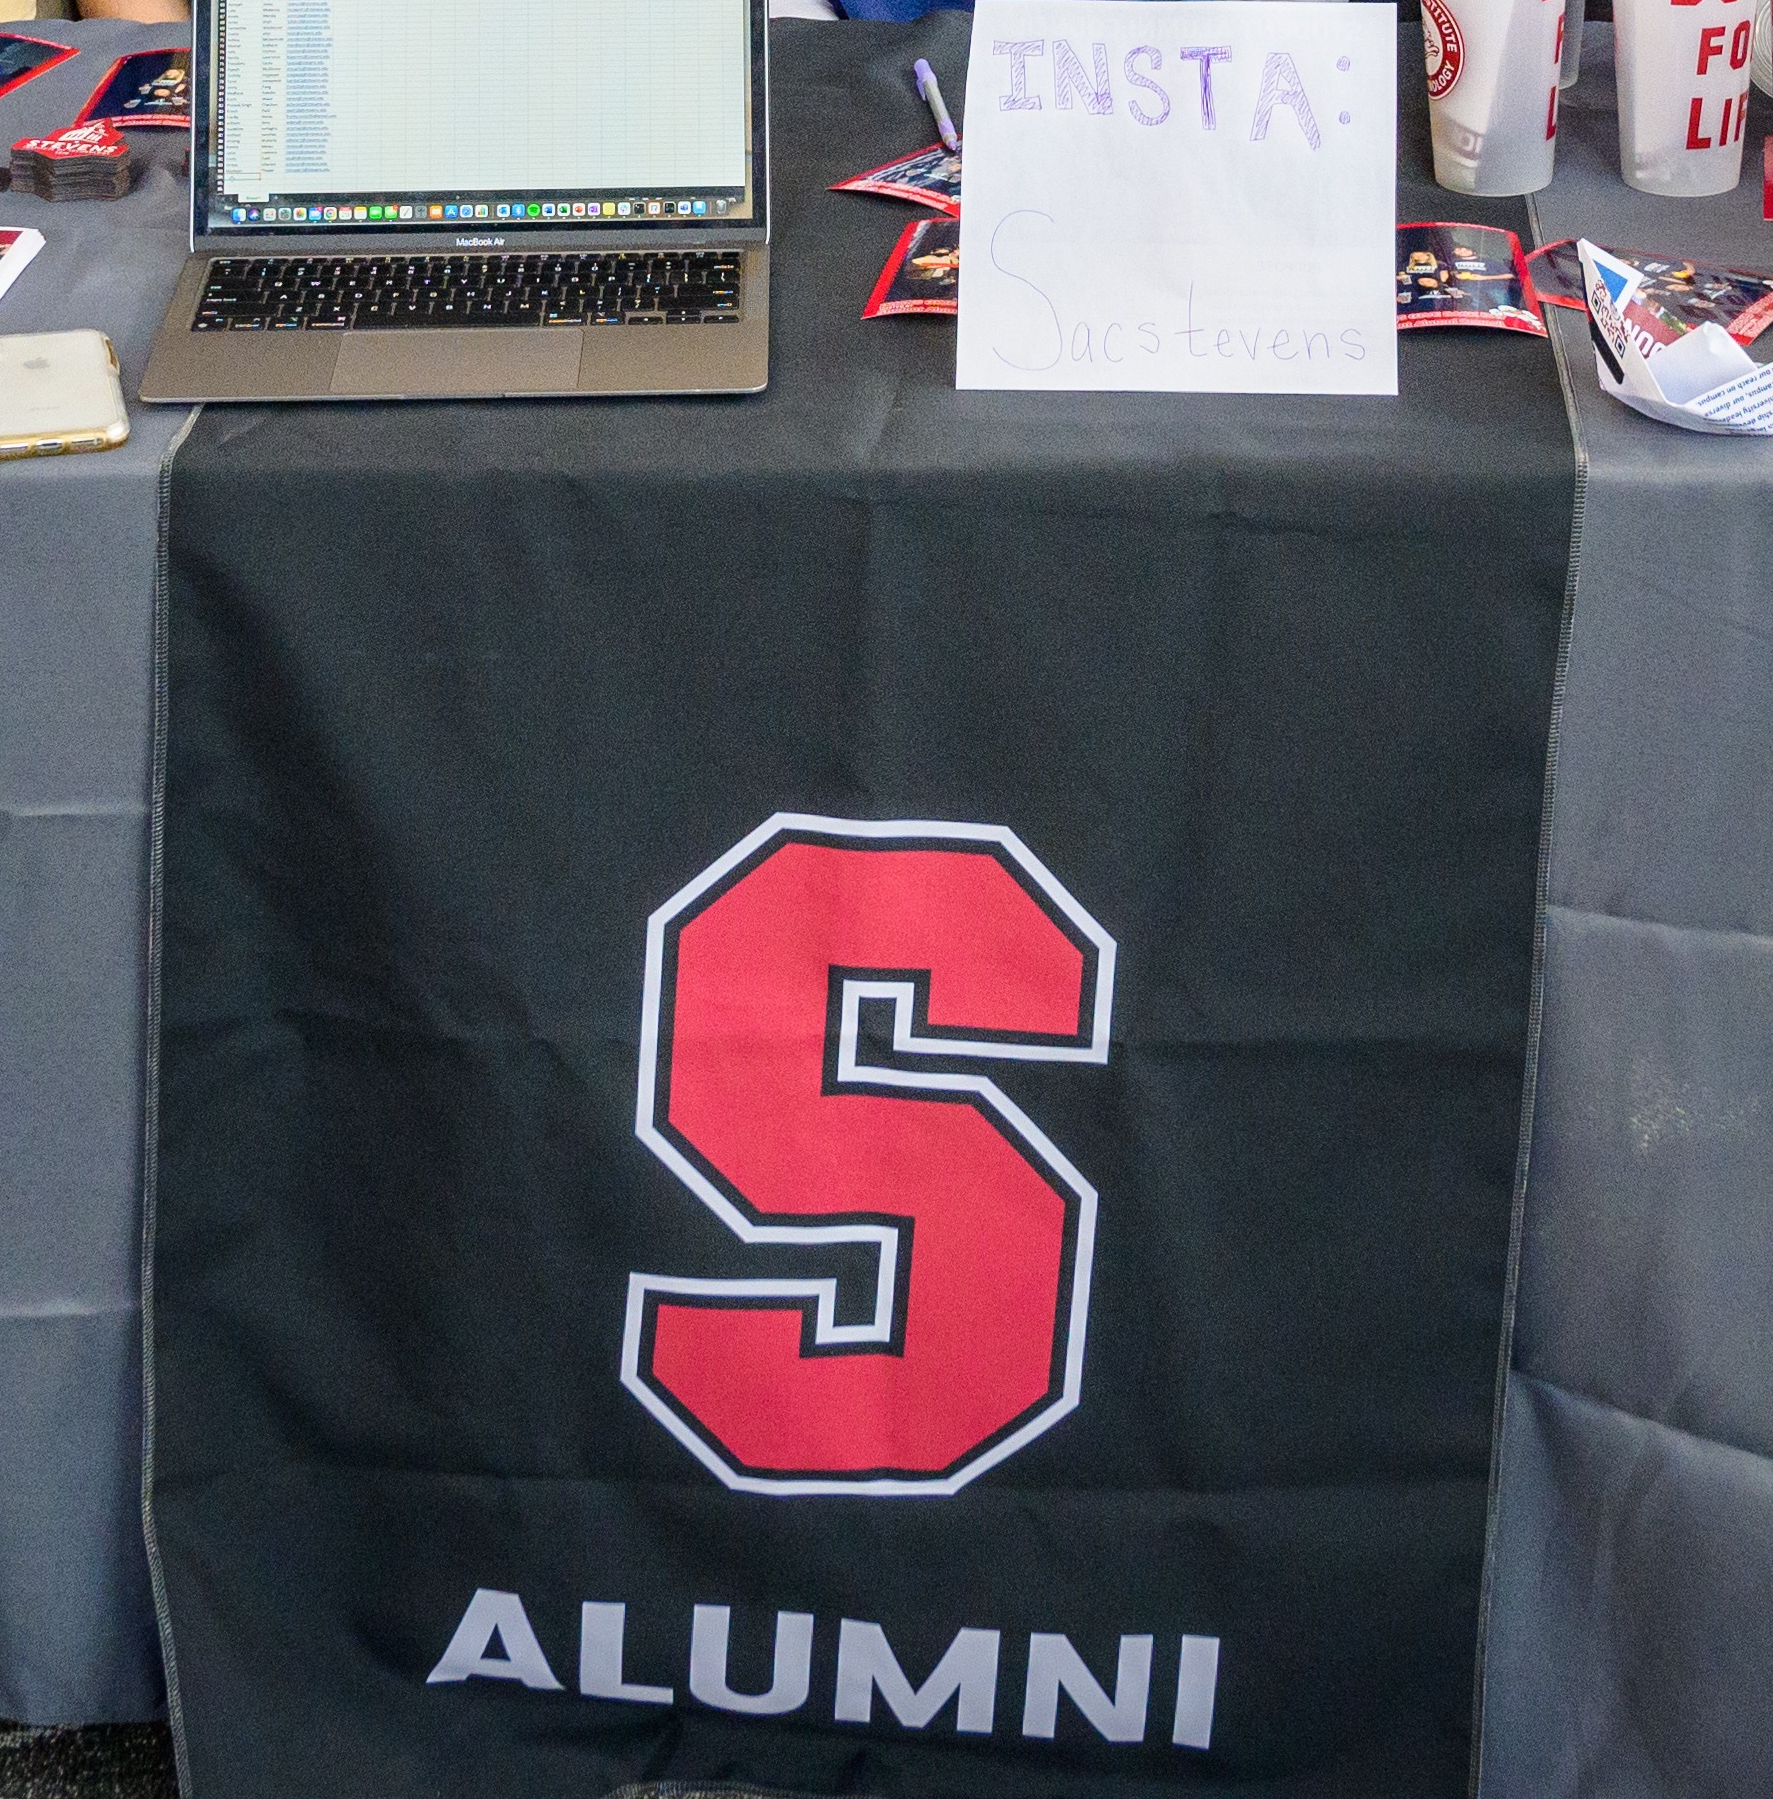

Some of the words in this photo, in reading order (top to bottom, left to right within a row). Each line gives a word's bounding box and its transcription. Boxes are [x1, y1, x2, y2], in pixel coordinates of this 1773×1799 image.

[1696, 20, 1753, 77] FO
[993, 38, 1352, 150] INSTA:
[1686, 91, 1747, 150] LIF
[28, 140, 118, 153] STEVENS
[456, 237, 493, 247] MacBook
[493, 237, 505, 246] Air
[619, 812, 1118, 1497] S
[427, 1588, 1221, 1750] ALUMNI
